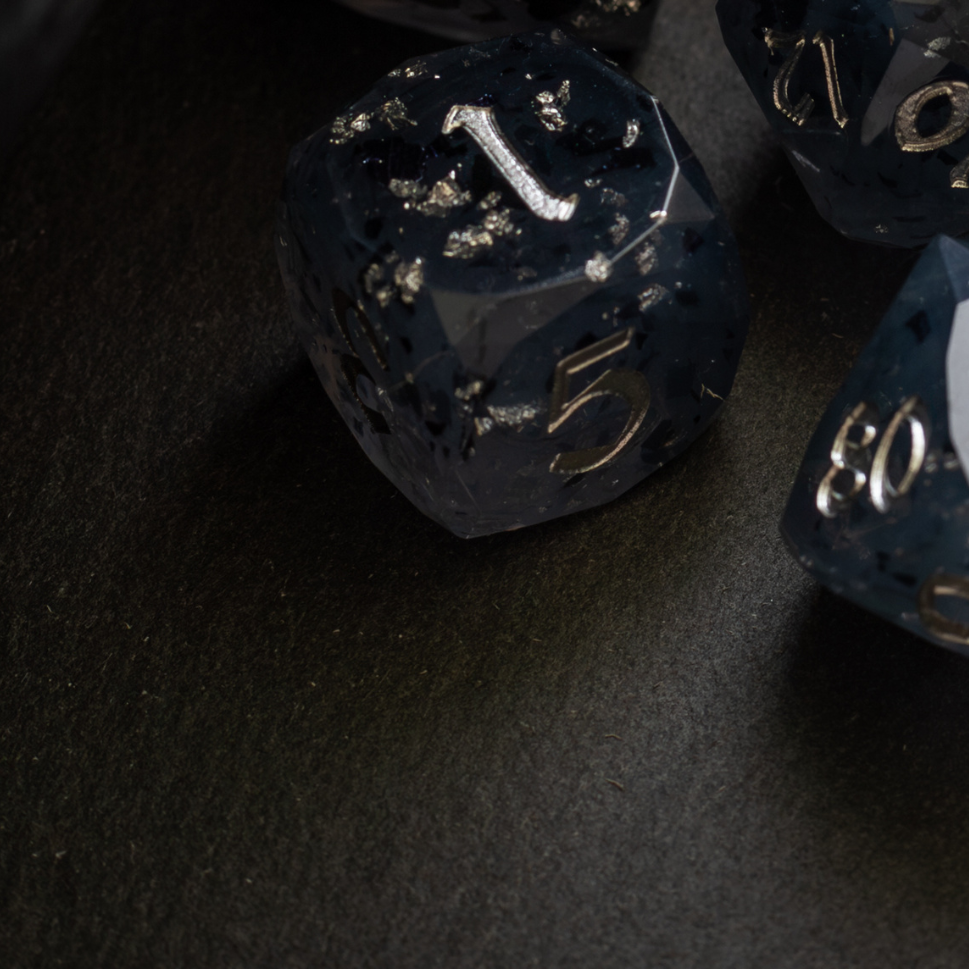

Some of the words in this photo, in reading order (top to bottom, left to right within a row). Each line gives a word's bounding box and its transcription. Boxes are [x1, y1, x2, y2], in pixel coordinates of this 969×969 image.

[443, 105, 581, 222] 1
[547, 326, 651, 474] 5
[816, 395, 930, 515] 80
